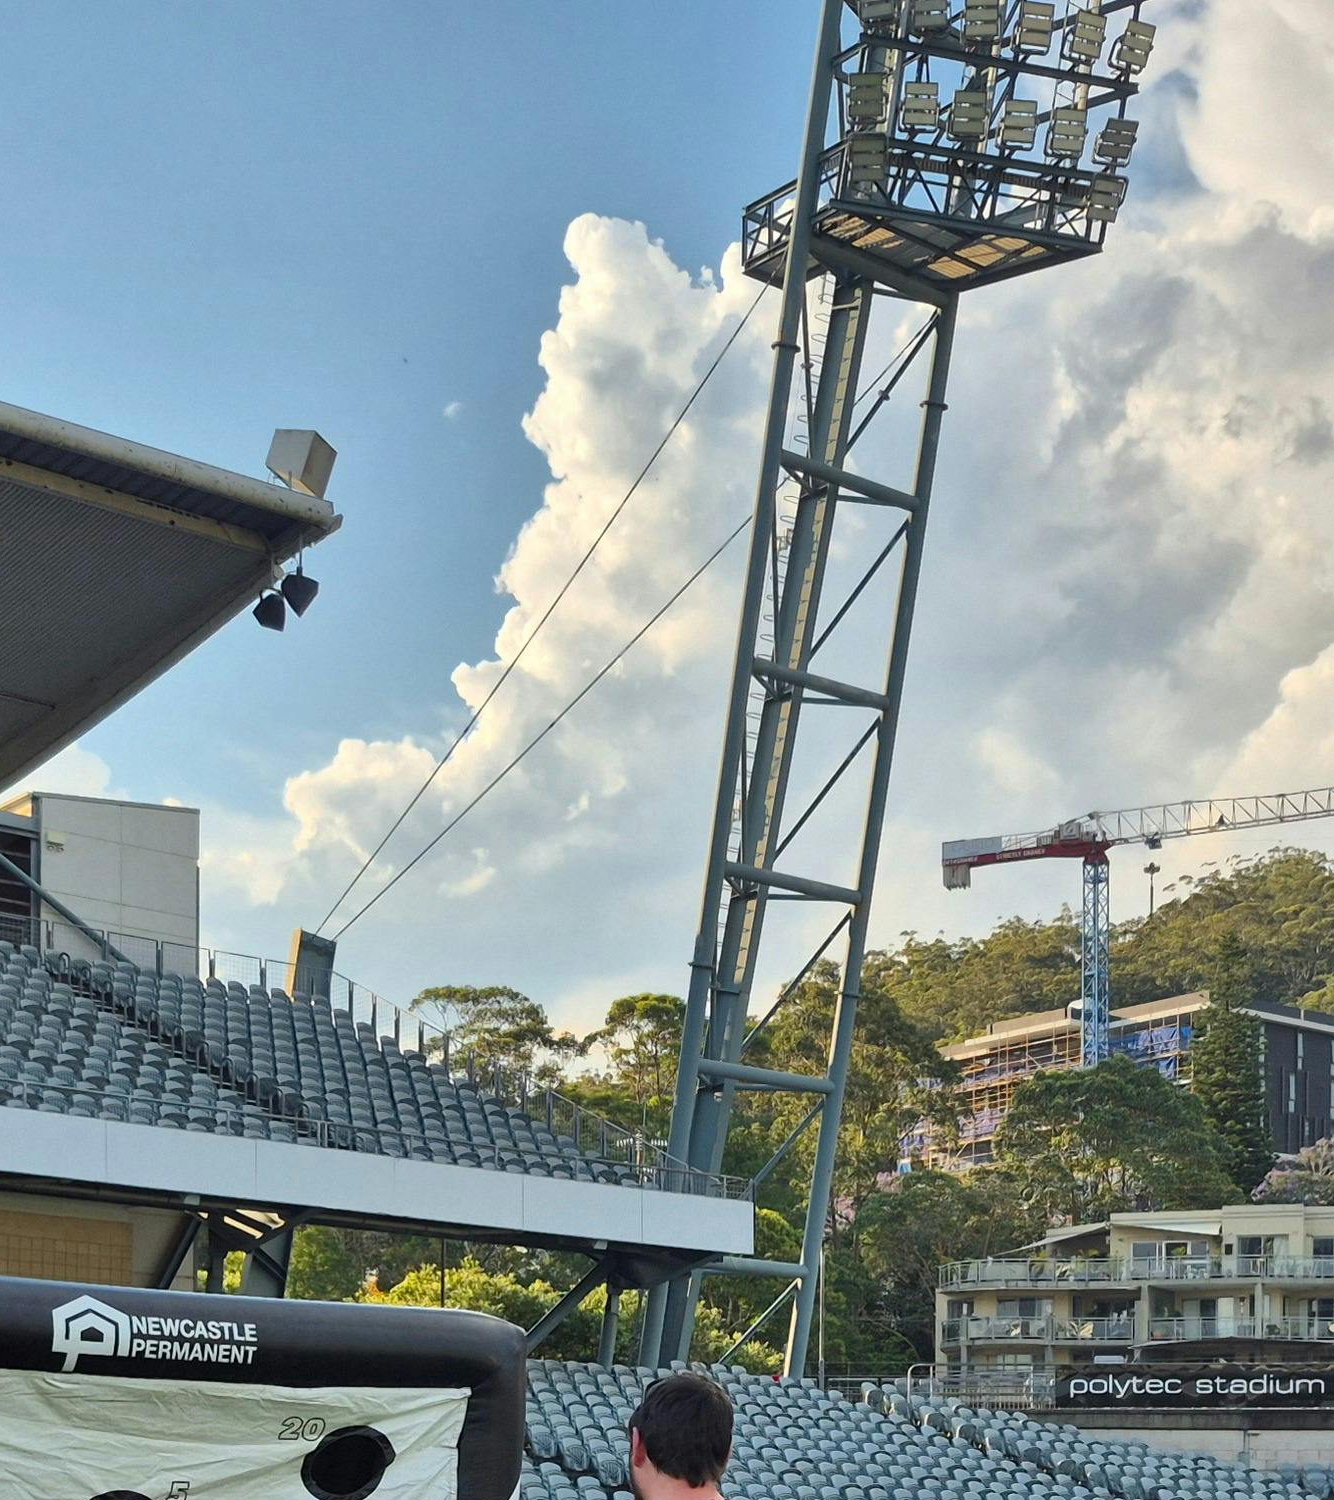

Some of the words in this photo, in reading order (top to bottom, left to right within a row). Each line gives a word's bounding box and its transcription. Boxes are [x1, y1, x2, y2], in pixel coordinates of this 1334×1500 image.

[131, 1315, 259, 1343] NEWCASTLE
[131, 1338, 258, 1365] PERMANENT
[1069, 1373, 1183, 1399] polytec
[1195, 1373, 1326, 1395] stadium
[278, 1416, 327, 1442] 20
